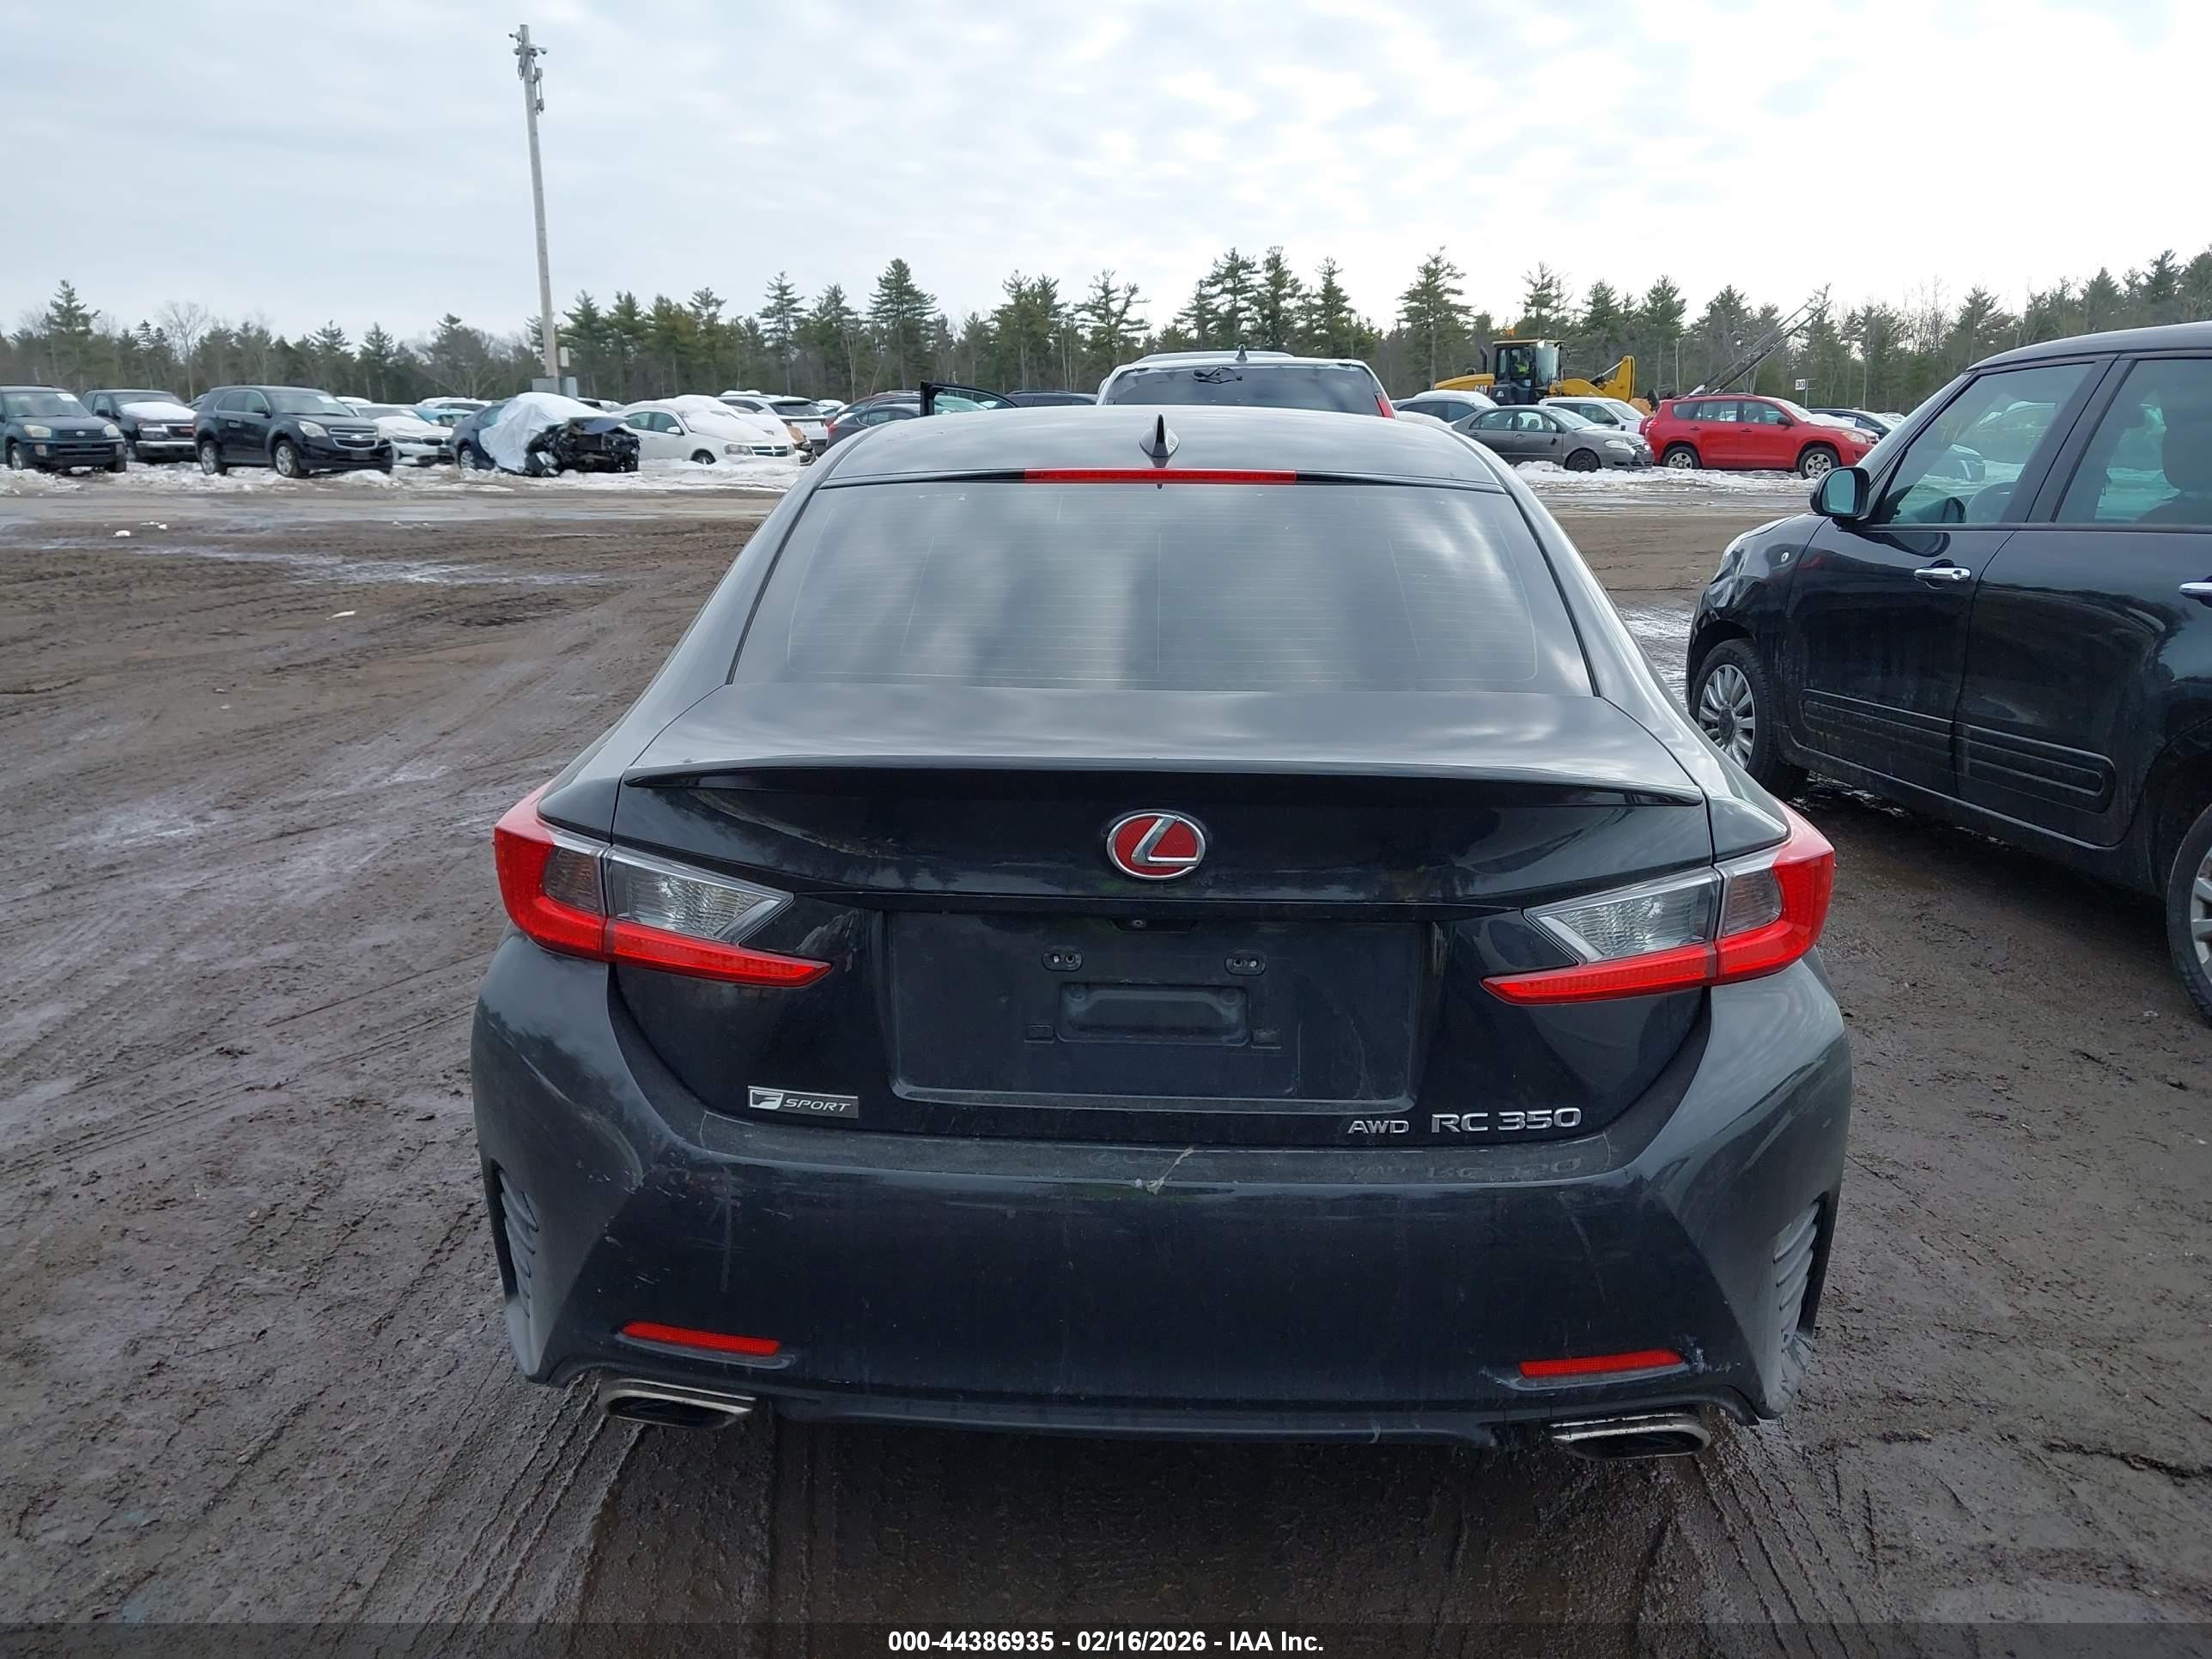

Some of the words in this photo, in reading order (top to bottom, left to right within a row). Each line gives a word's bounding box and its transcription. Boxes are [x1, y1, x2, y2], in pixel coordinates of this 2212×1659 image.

[1474, 385, 1488, 394] CAT
[783, 1097, 852, 1112] SPORT
[1347, 1120, 1410, 1134] AWD
[1431, 1112, 1489, 1133] RC
[1498, 1107, 1583, 1132] 350
